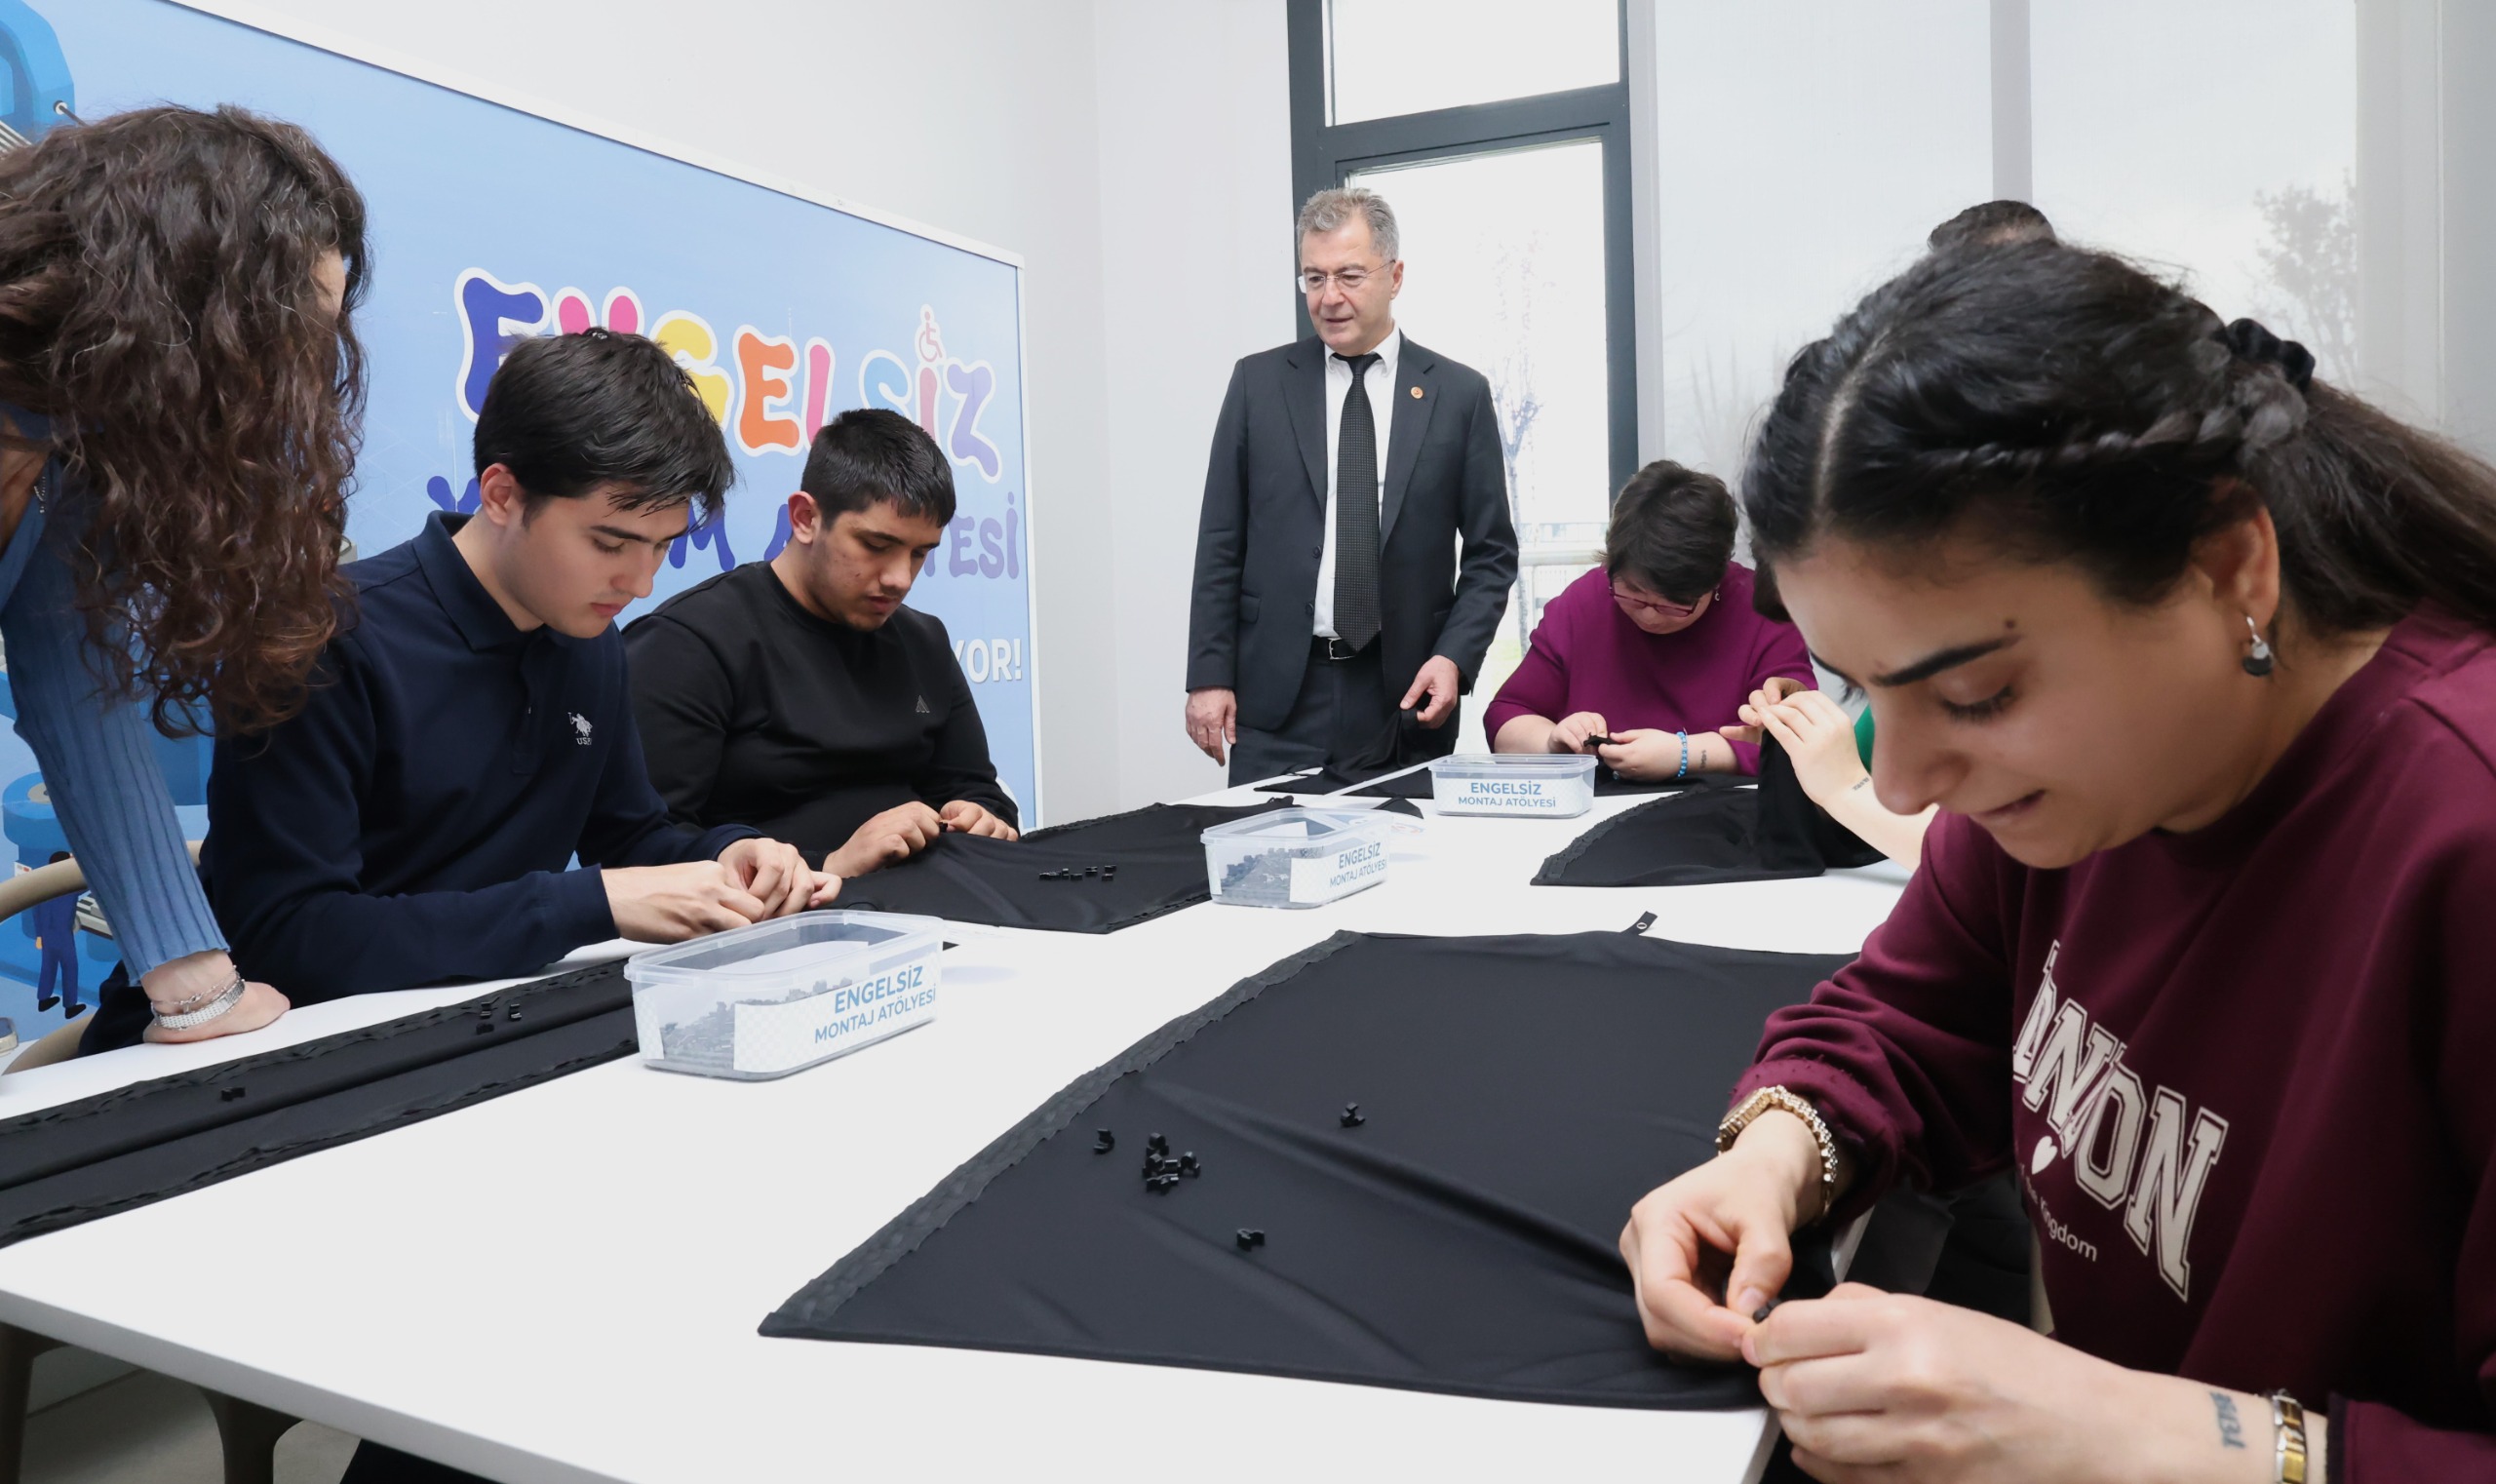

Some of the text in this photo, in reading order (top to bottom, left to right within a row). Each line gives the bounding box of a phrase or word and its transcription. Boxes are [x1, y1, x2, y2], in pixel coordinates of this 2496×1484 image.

[1470, 781, 1542, 796] ENGELSİZ
[1459, 797, 1556, 808] MONTAJ ATÖLYESİ
[1339, 840, 1382, 869] ENGELSİZ
[1330, 869, 1358, 888] MONTAJ
[834, 964, 923, 1014] ENGELSİZ
[815, 983, 936, 1044] MONTAJ ATÖLYESİ
